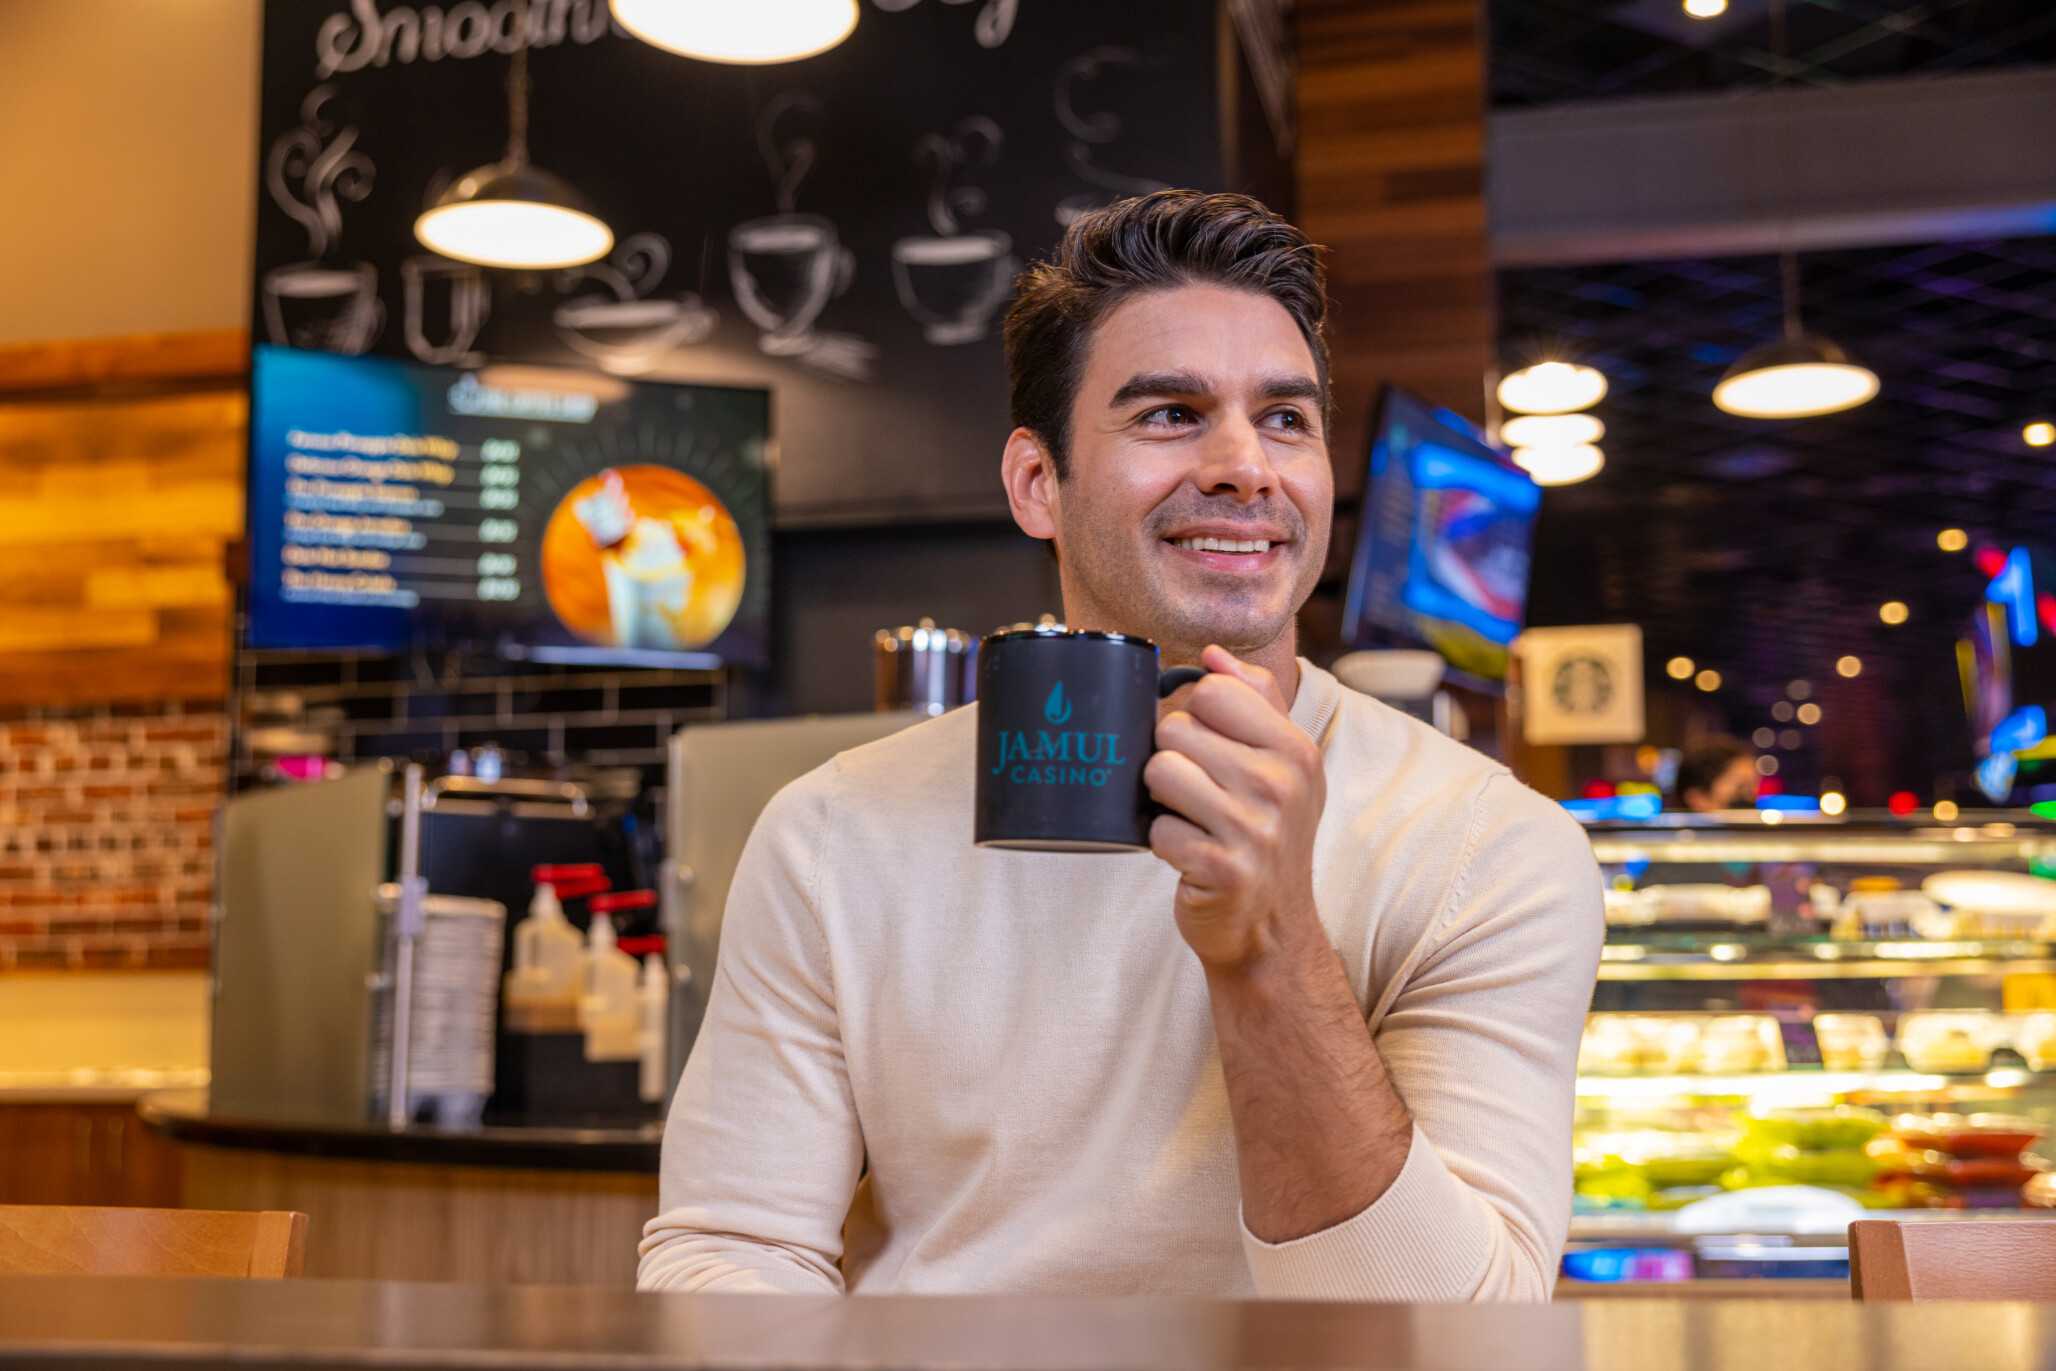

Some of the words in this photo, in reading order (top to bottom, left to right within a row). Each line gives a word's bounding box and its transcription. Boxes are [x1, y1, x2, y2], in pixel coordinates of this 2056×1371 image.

[315, 0, 628, 79] Smooth
[992, 729, 1127, 775] JAMUL
[1009, 765, 1108, 787] CASINO
